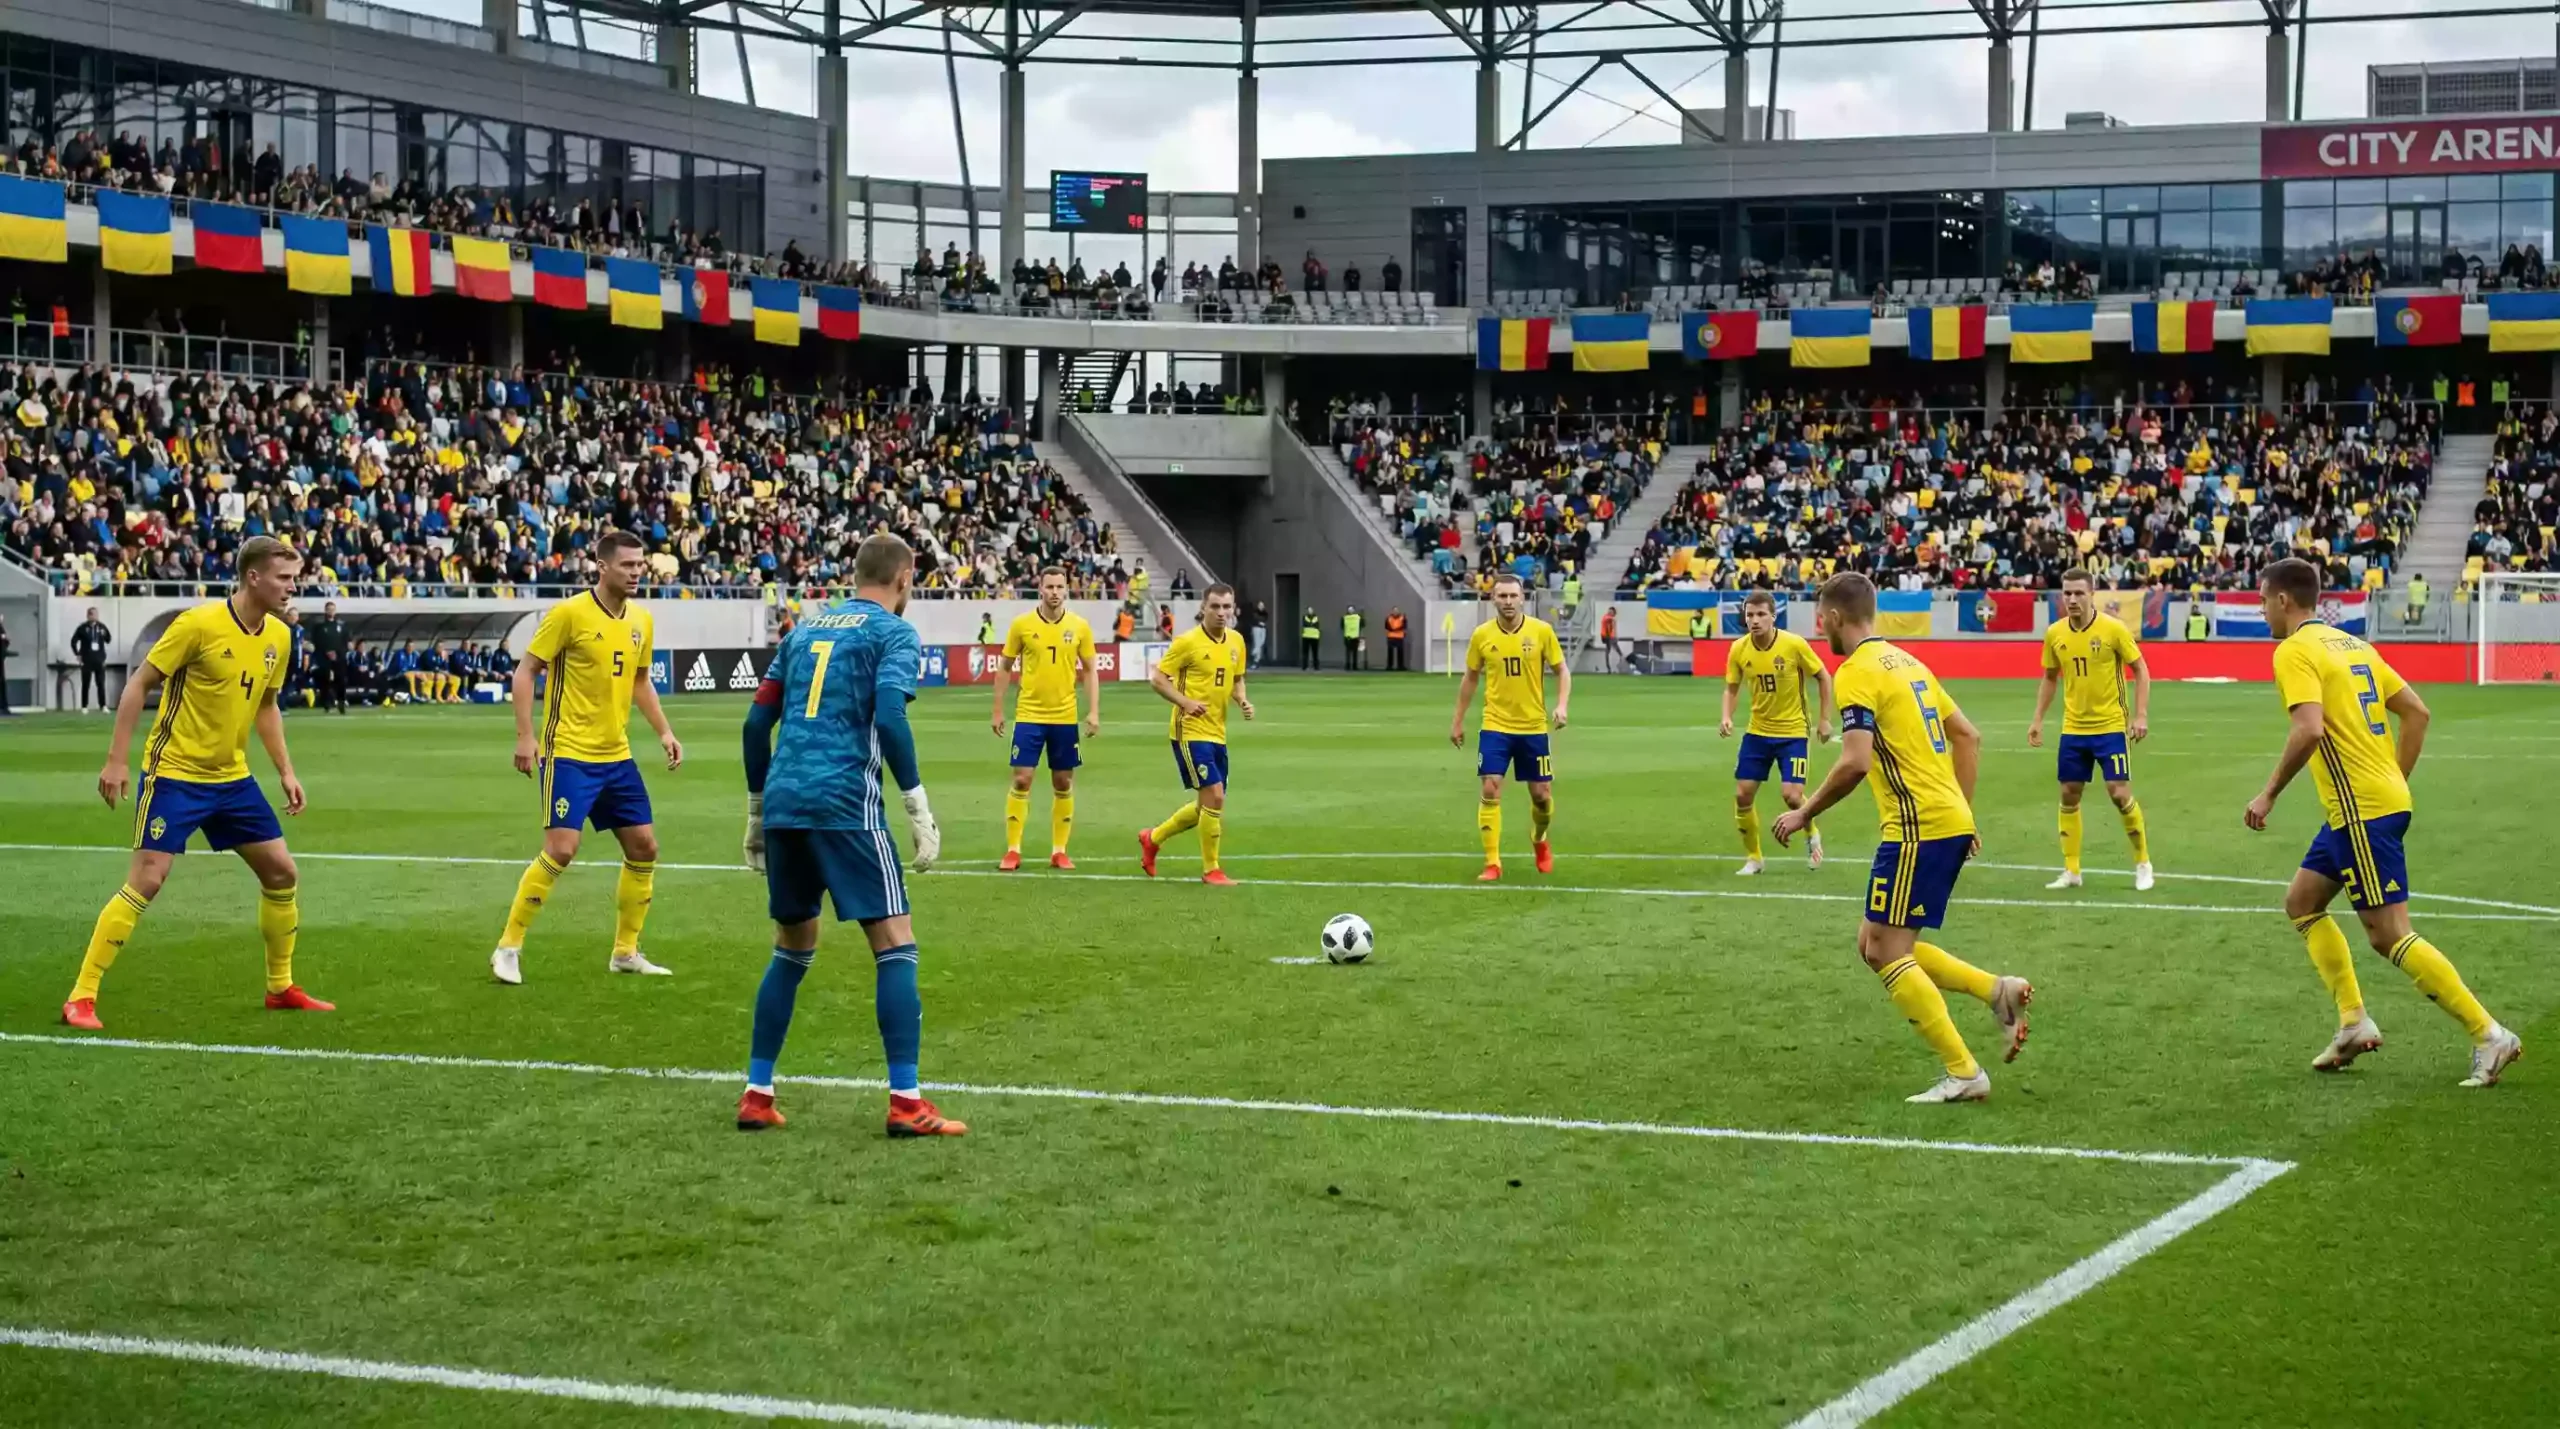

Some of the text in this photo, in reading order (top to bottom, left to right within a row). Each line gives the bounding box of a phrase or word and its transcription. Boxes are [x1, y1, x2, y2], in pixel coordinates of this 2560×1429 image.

[2318, 126, 2560, 166] CITY AREN
[612, 651, 624, 677] 5
[1047, 646, 1057, 664] 7
[1503, 657, 1522, 676] 10
[2073, 657, 2088, 676] 11
[240, 670, 254, 700] 4
[685, 676, 716, 690] adidas
[1757, 674, 1777, 693] 18
[2350, 665, 2386, 735] 2
[1910, 680, 1946, 753] 6
[1536, 755, 1553, 776] 10
[1790, 757, 1807, 778] 10
[2111, 753, 2128, 775] 11
[1870, 877, 1888, 912] 6
[2341, 867, 2362, 901] 2
